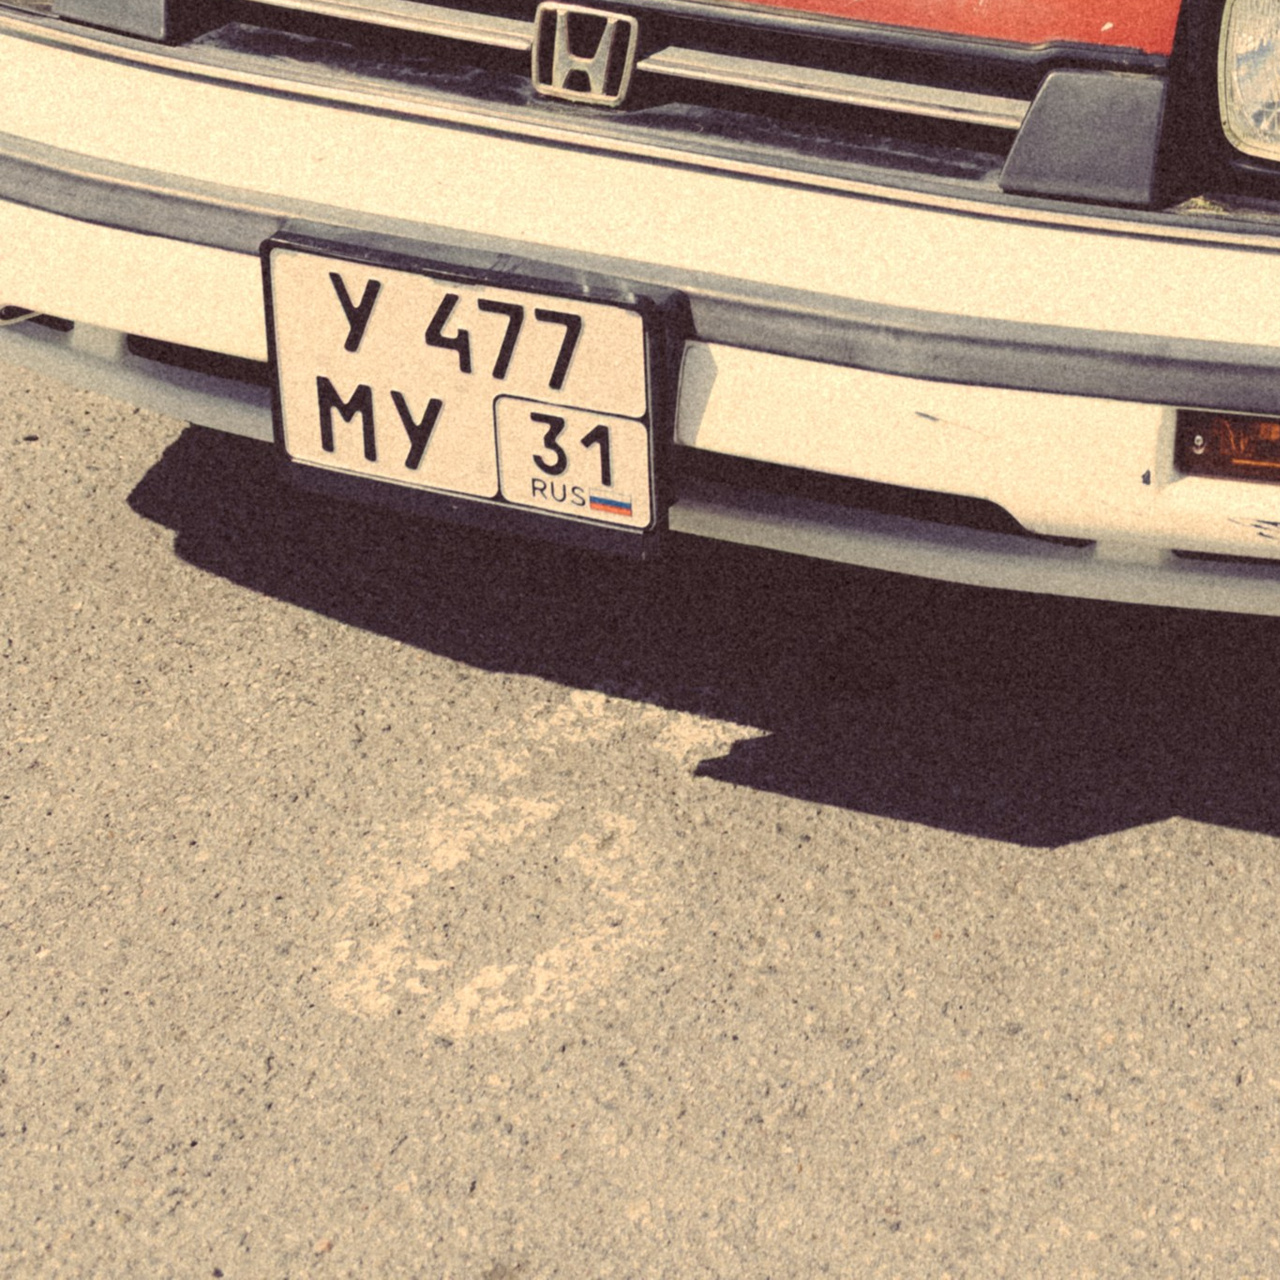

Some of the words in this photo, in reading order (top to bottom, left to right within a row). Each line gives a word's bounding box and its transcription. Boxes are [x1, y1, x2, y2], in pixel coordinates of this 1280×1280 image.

[551, 7, 619, 96] H
[329, 272, 382, 353] У
[425, 293, 583, 390] 477
[316, 376, 443, 470] МУ
[530, 412, 613, 487] 31
[530, 478, 587, 507] RUS
